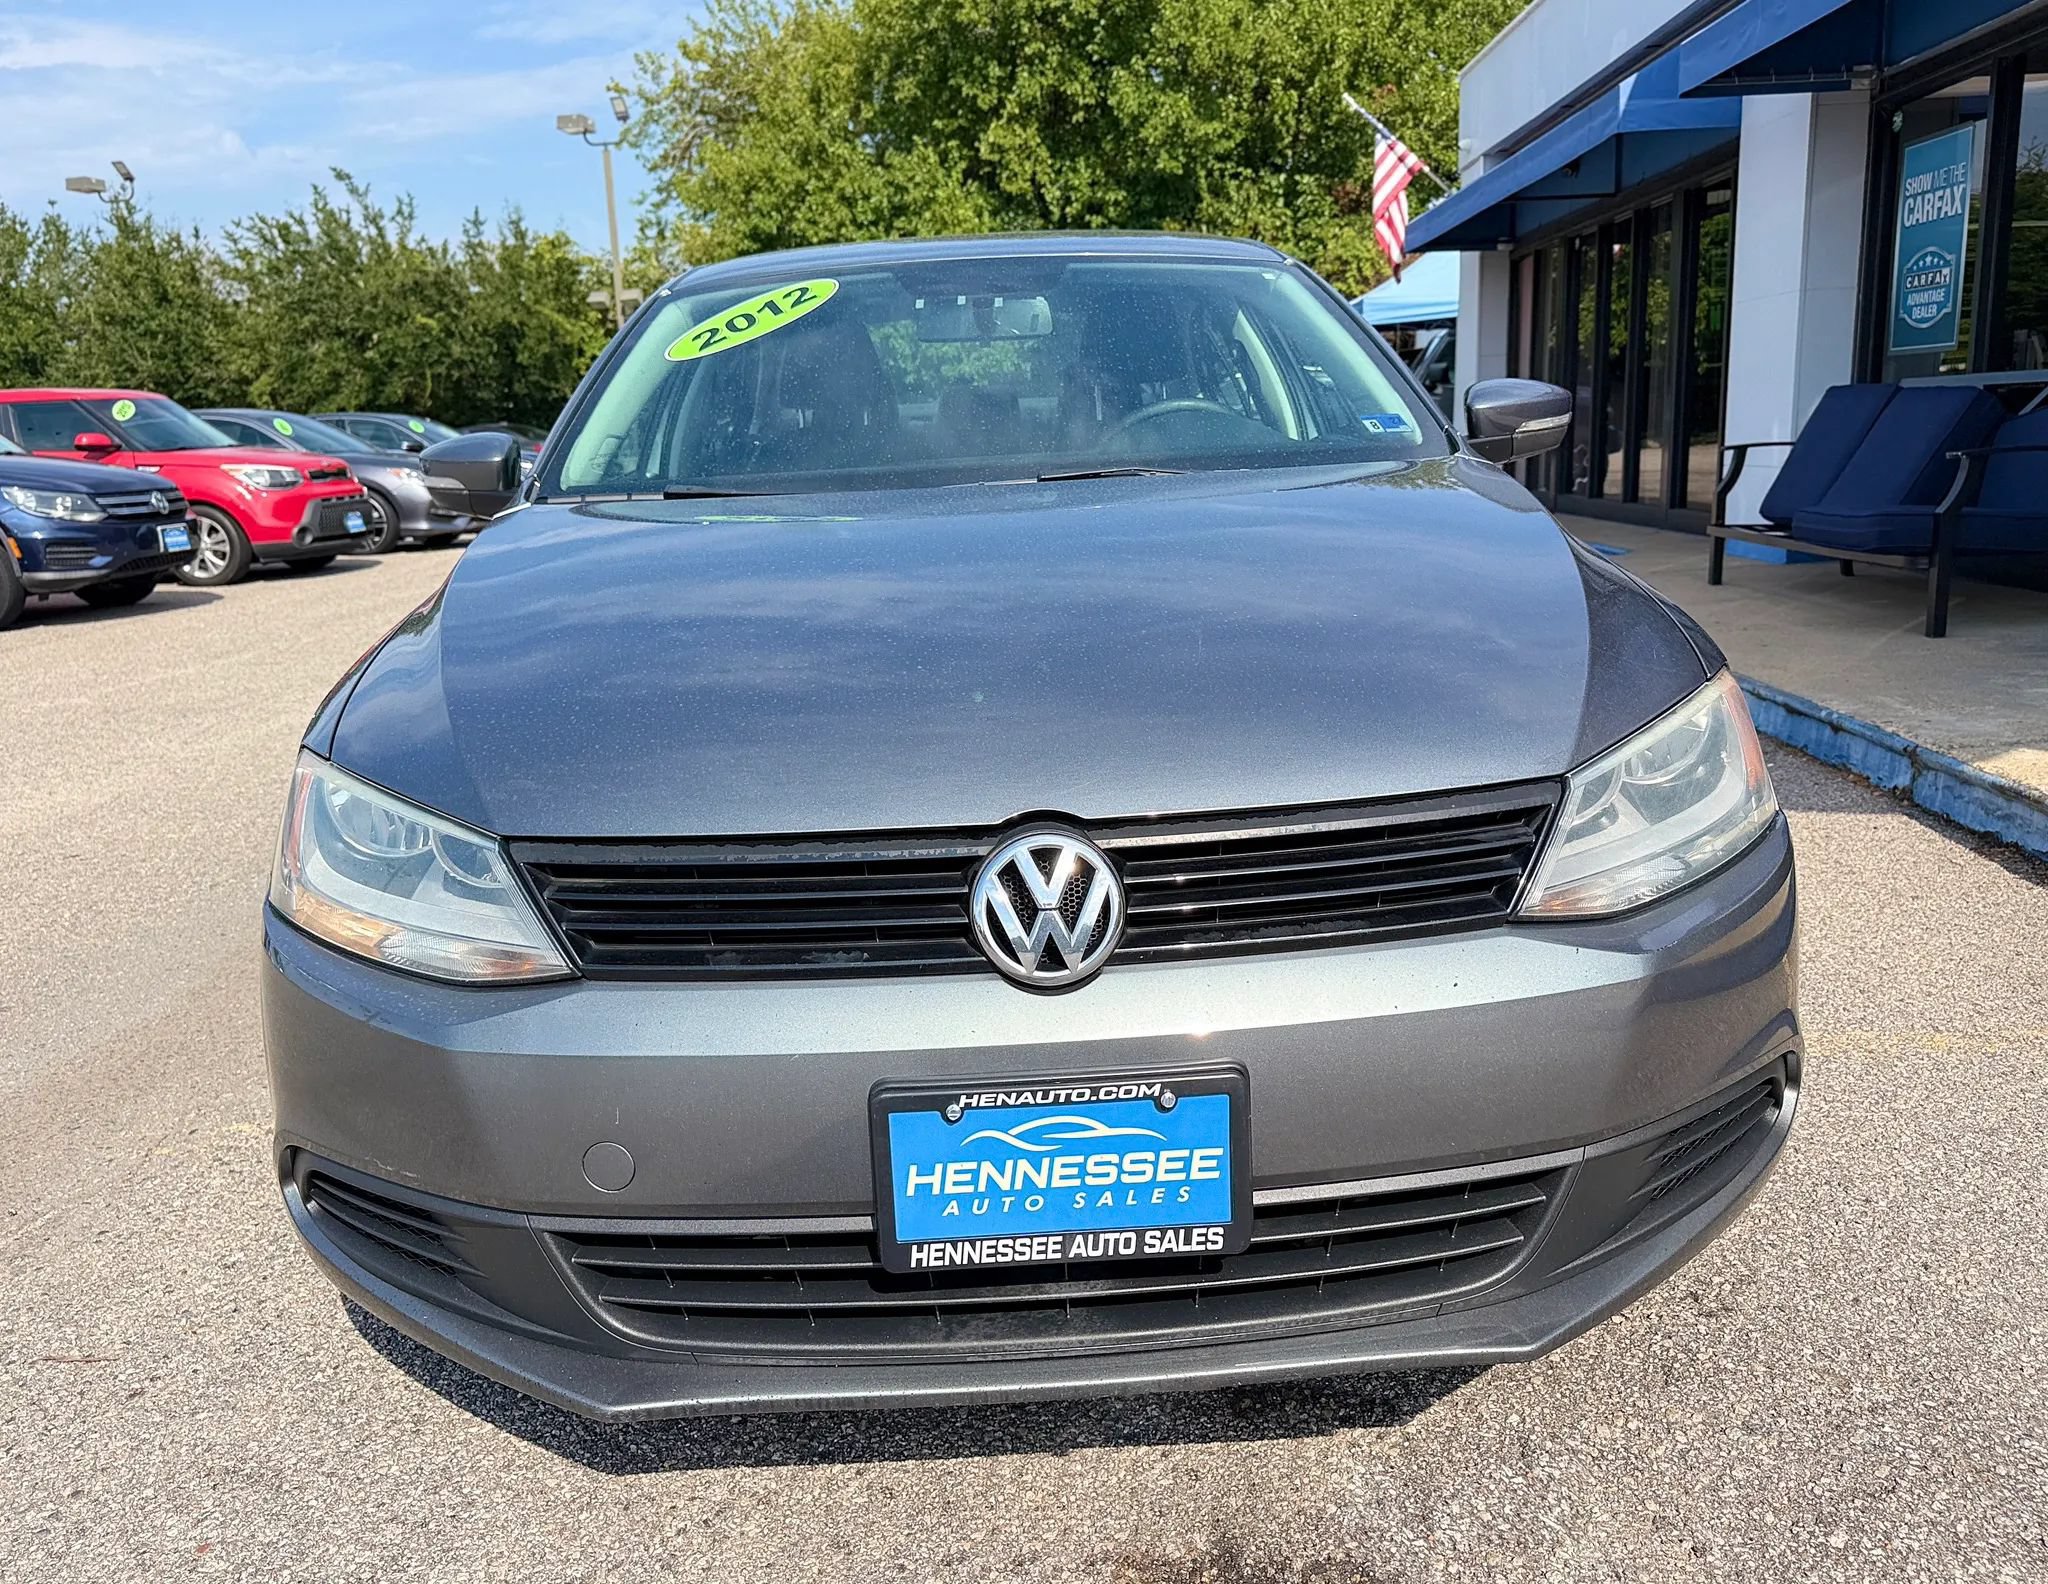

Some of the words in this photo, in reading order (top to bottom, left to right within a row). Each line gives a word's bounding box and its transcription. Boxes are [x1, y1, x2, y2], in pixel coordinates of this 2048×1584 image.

[1905, 171, 1933, 197] SHOW
[1933, 167, 1949, 189] ME
[1949, 161, 1967, 184] THE
[1903, 183, 1967, 228] CARFAX
[1906, 269, 1950, 289] CARFAX
[1906, 288, 1946, 306] ADVANTAGE
[1912, 303, 1938, 319] DEALER
[691, 286, 818, 353] 2012
[958, 1083, 1162, 1109] HENAUTO.COM
[905, 1146, 1224, 1197] HENNESSEE
[942, 1192, 1045, 1217] AUTO
[1073, 1185, 1192, 1210] SALES
[910, 1235, 1062, 1269] HENNESSEE
[1069, 1231, 1136, 1259] AUTO
[1143, 1227, 1225, 1254] SALES
